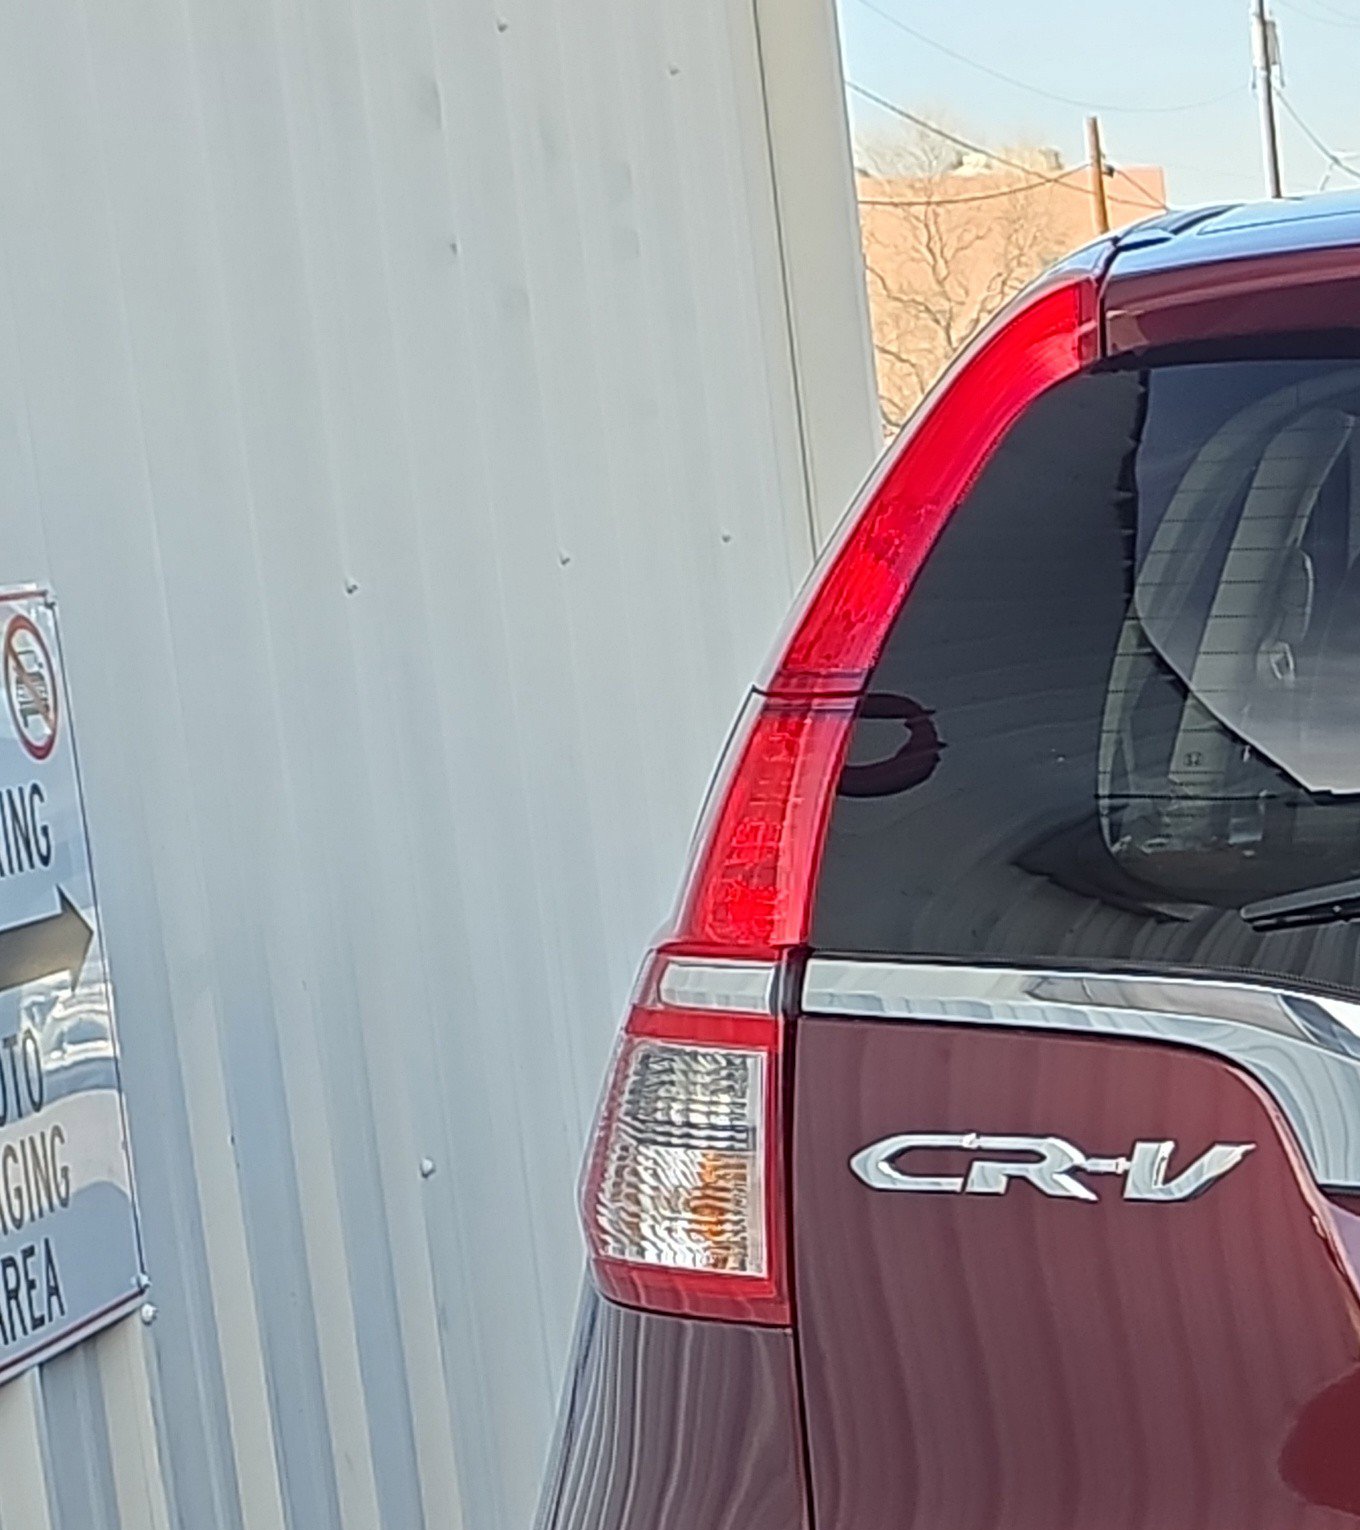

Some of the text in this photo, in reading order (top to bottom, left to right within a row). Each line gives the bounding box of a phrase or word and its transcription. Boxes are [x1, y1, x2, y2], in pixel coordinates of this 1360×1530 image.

[0, 782, 52, 877] ING
[0, 1125, 70, 1236] GING
[849, 1132, 1257, 1202] CR-V
[0, 1237, 66, 1346] REA
